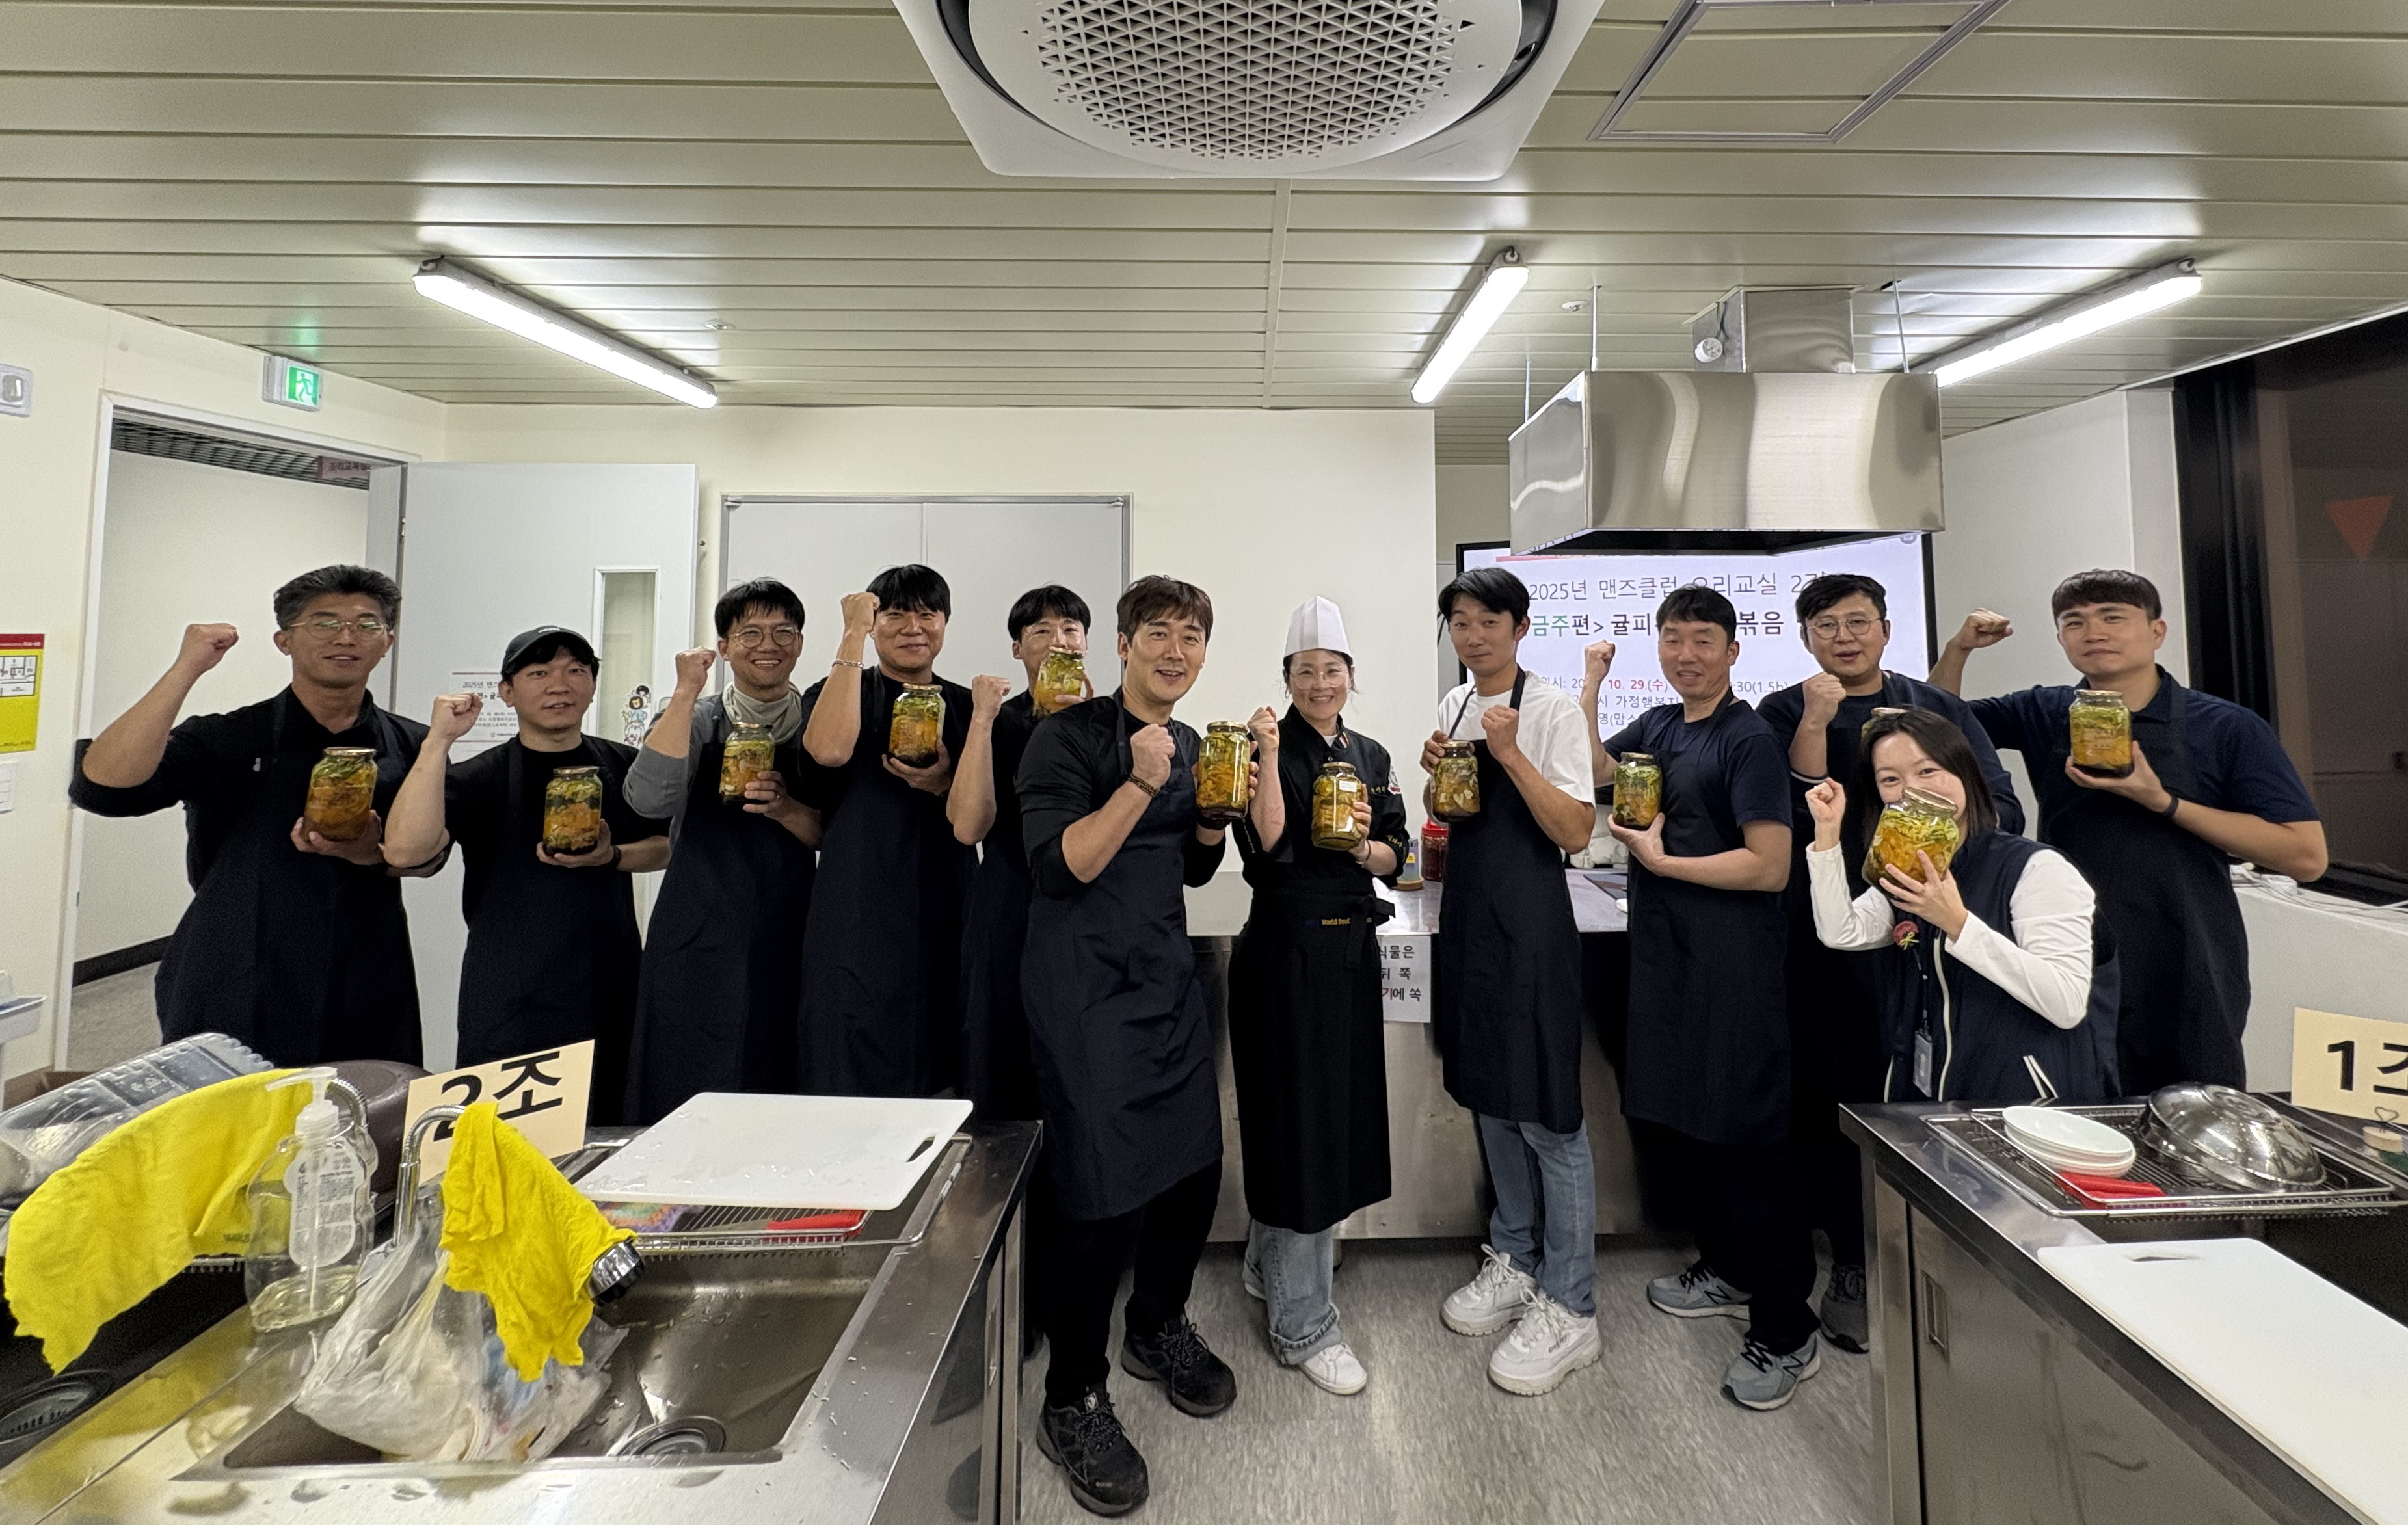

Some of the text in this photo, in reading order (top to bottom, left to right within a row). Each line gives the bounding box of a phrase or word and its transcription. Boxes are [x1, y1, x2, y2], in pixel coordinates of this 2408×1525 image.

[1529, 579, 1587, 600] 2025년
[1599, 576, 1677, 599] 맨즈클럽
[1398, 968, 1411, 980] 쪽
[1409, 987, 1422, 1001] 쏙
[433, 1051, 563, 1142] 2조
